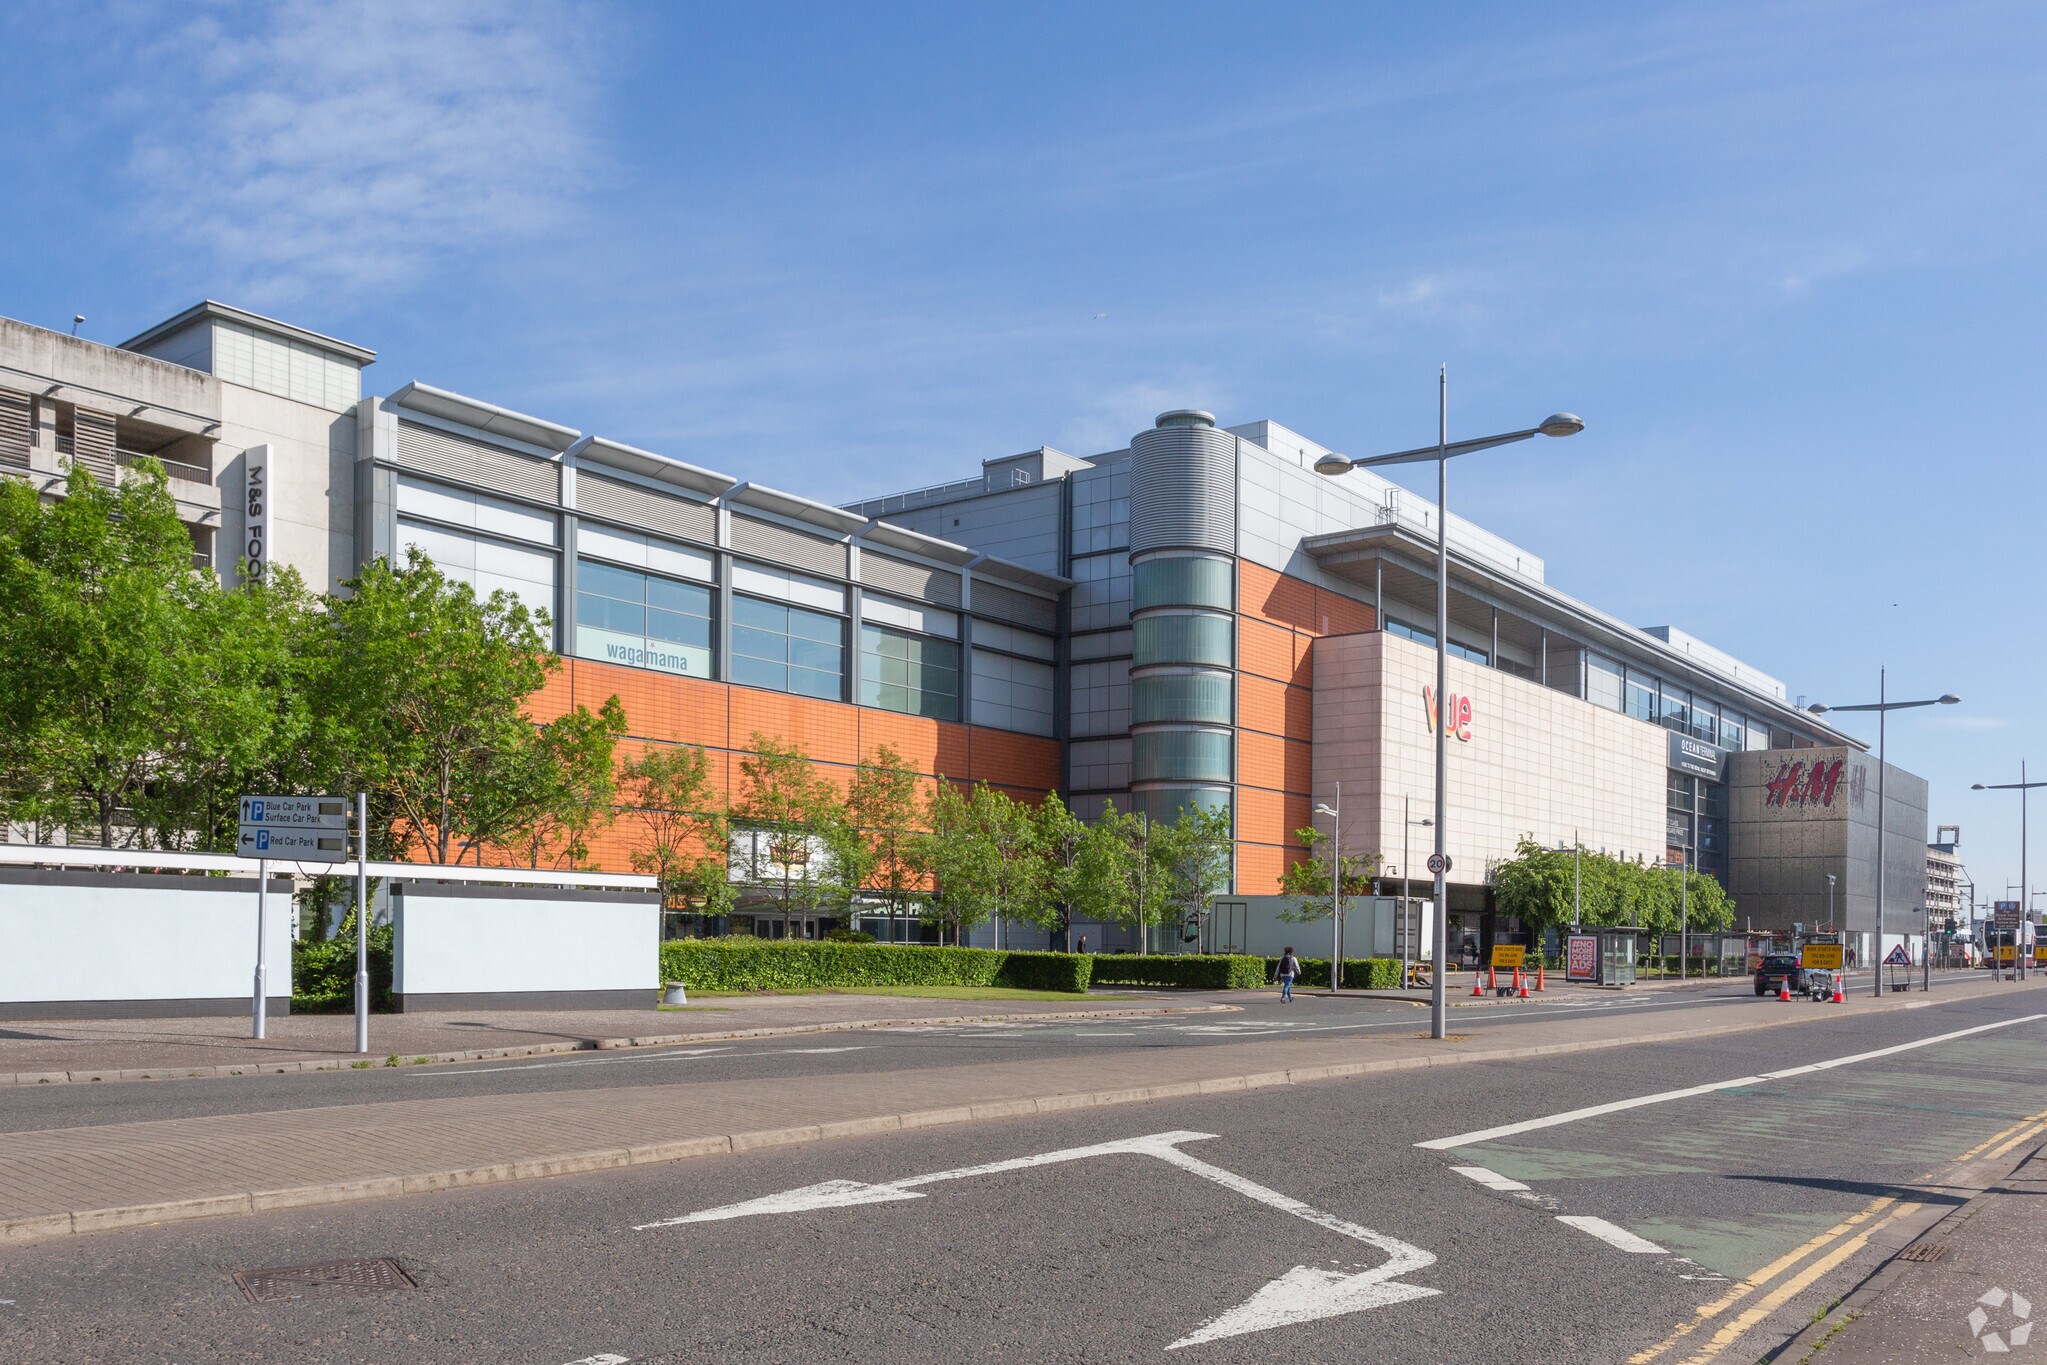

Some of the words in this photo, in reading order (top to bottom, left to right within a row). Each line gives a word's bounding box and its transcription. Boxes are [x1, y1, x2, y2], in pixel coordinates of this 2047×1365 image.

[248, 465, 262, 518] M&S
[606, 643, 688, 671] wagamama
[1681, 739, 1700, 755] OCEAN
[1700, 745, 1717, 760] TERMINAL
[1765, 760, 1843, 808] H&M
[266, 801, 281, 811] Blue
[282, 802, 295, 811] Car
[296, 802, 312, 812] Park
[265, 813, 291, 822] Surface
[292, 814, 305, 823] Car
[306, 814, 321, 824] Park
[270, 836, 283, 845] Red
[284, 837, 297, 846] Car
[298, 837, 315, 847] Park
[1430, 859, 1443, 868] 20
[1571, 940, 1594, 948] #NO
[1571, 947, 1593, 955] MORE
[1571, 960, 1593, 970] ADS
